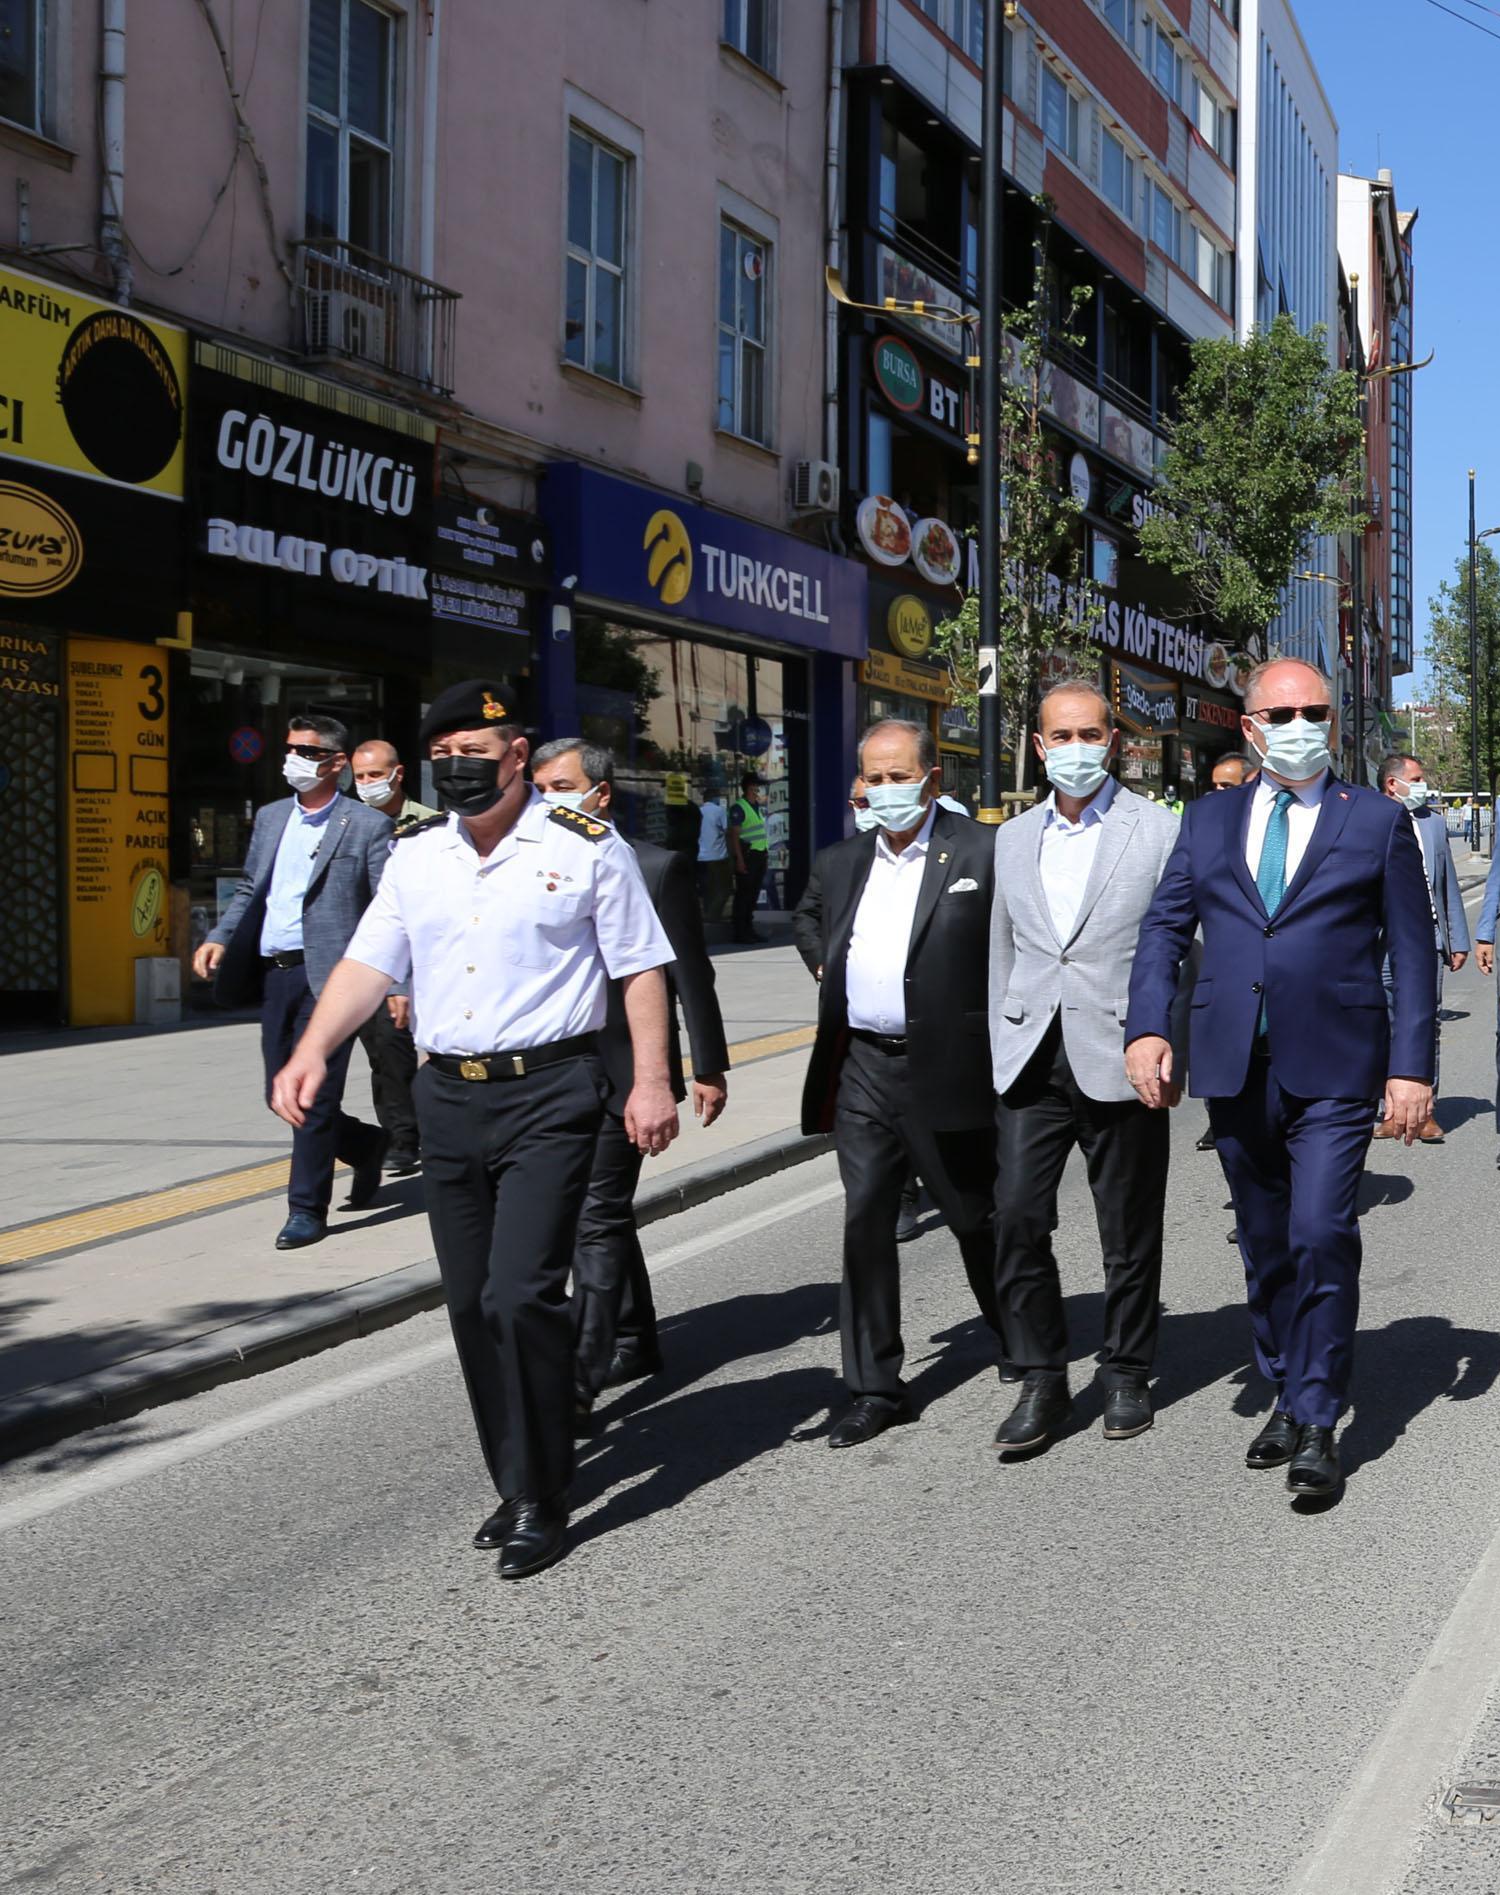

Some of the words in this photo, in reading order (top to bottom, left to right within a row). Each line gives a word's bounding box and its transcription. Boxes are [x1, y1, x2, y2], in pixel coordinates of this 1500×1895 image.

[882, 348, 917, 389] BURSA
[930, 377, 959, 429] BT
[216, 408, 417, 517] GÖZLÜKÇÜ
[206, 517, 326, 577] BULUT
[330, 547, 429, 601] OPTİK
[701, 543, 830, 625] TURKCELL
[1123, 601, 1205, 679] KÖFTECİSİ
[138, 664, 165, 722] 3
[1185, 695, 1199, 720] BT
[137, 730, 165, 747] GÜN
[136, 809, 166, 827] AÇIK
